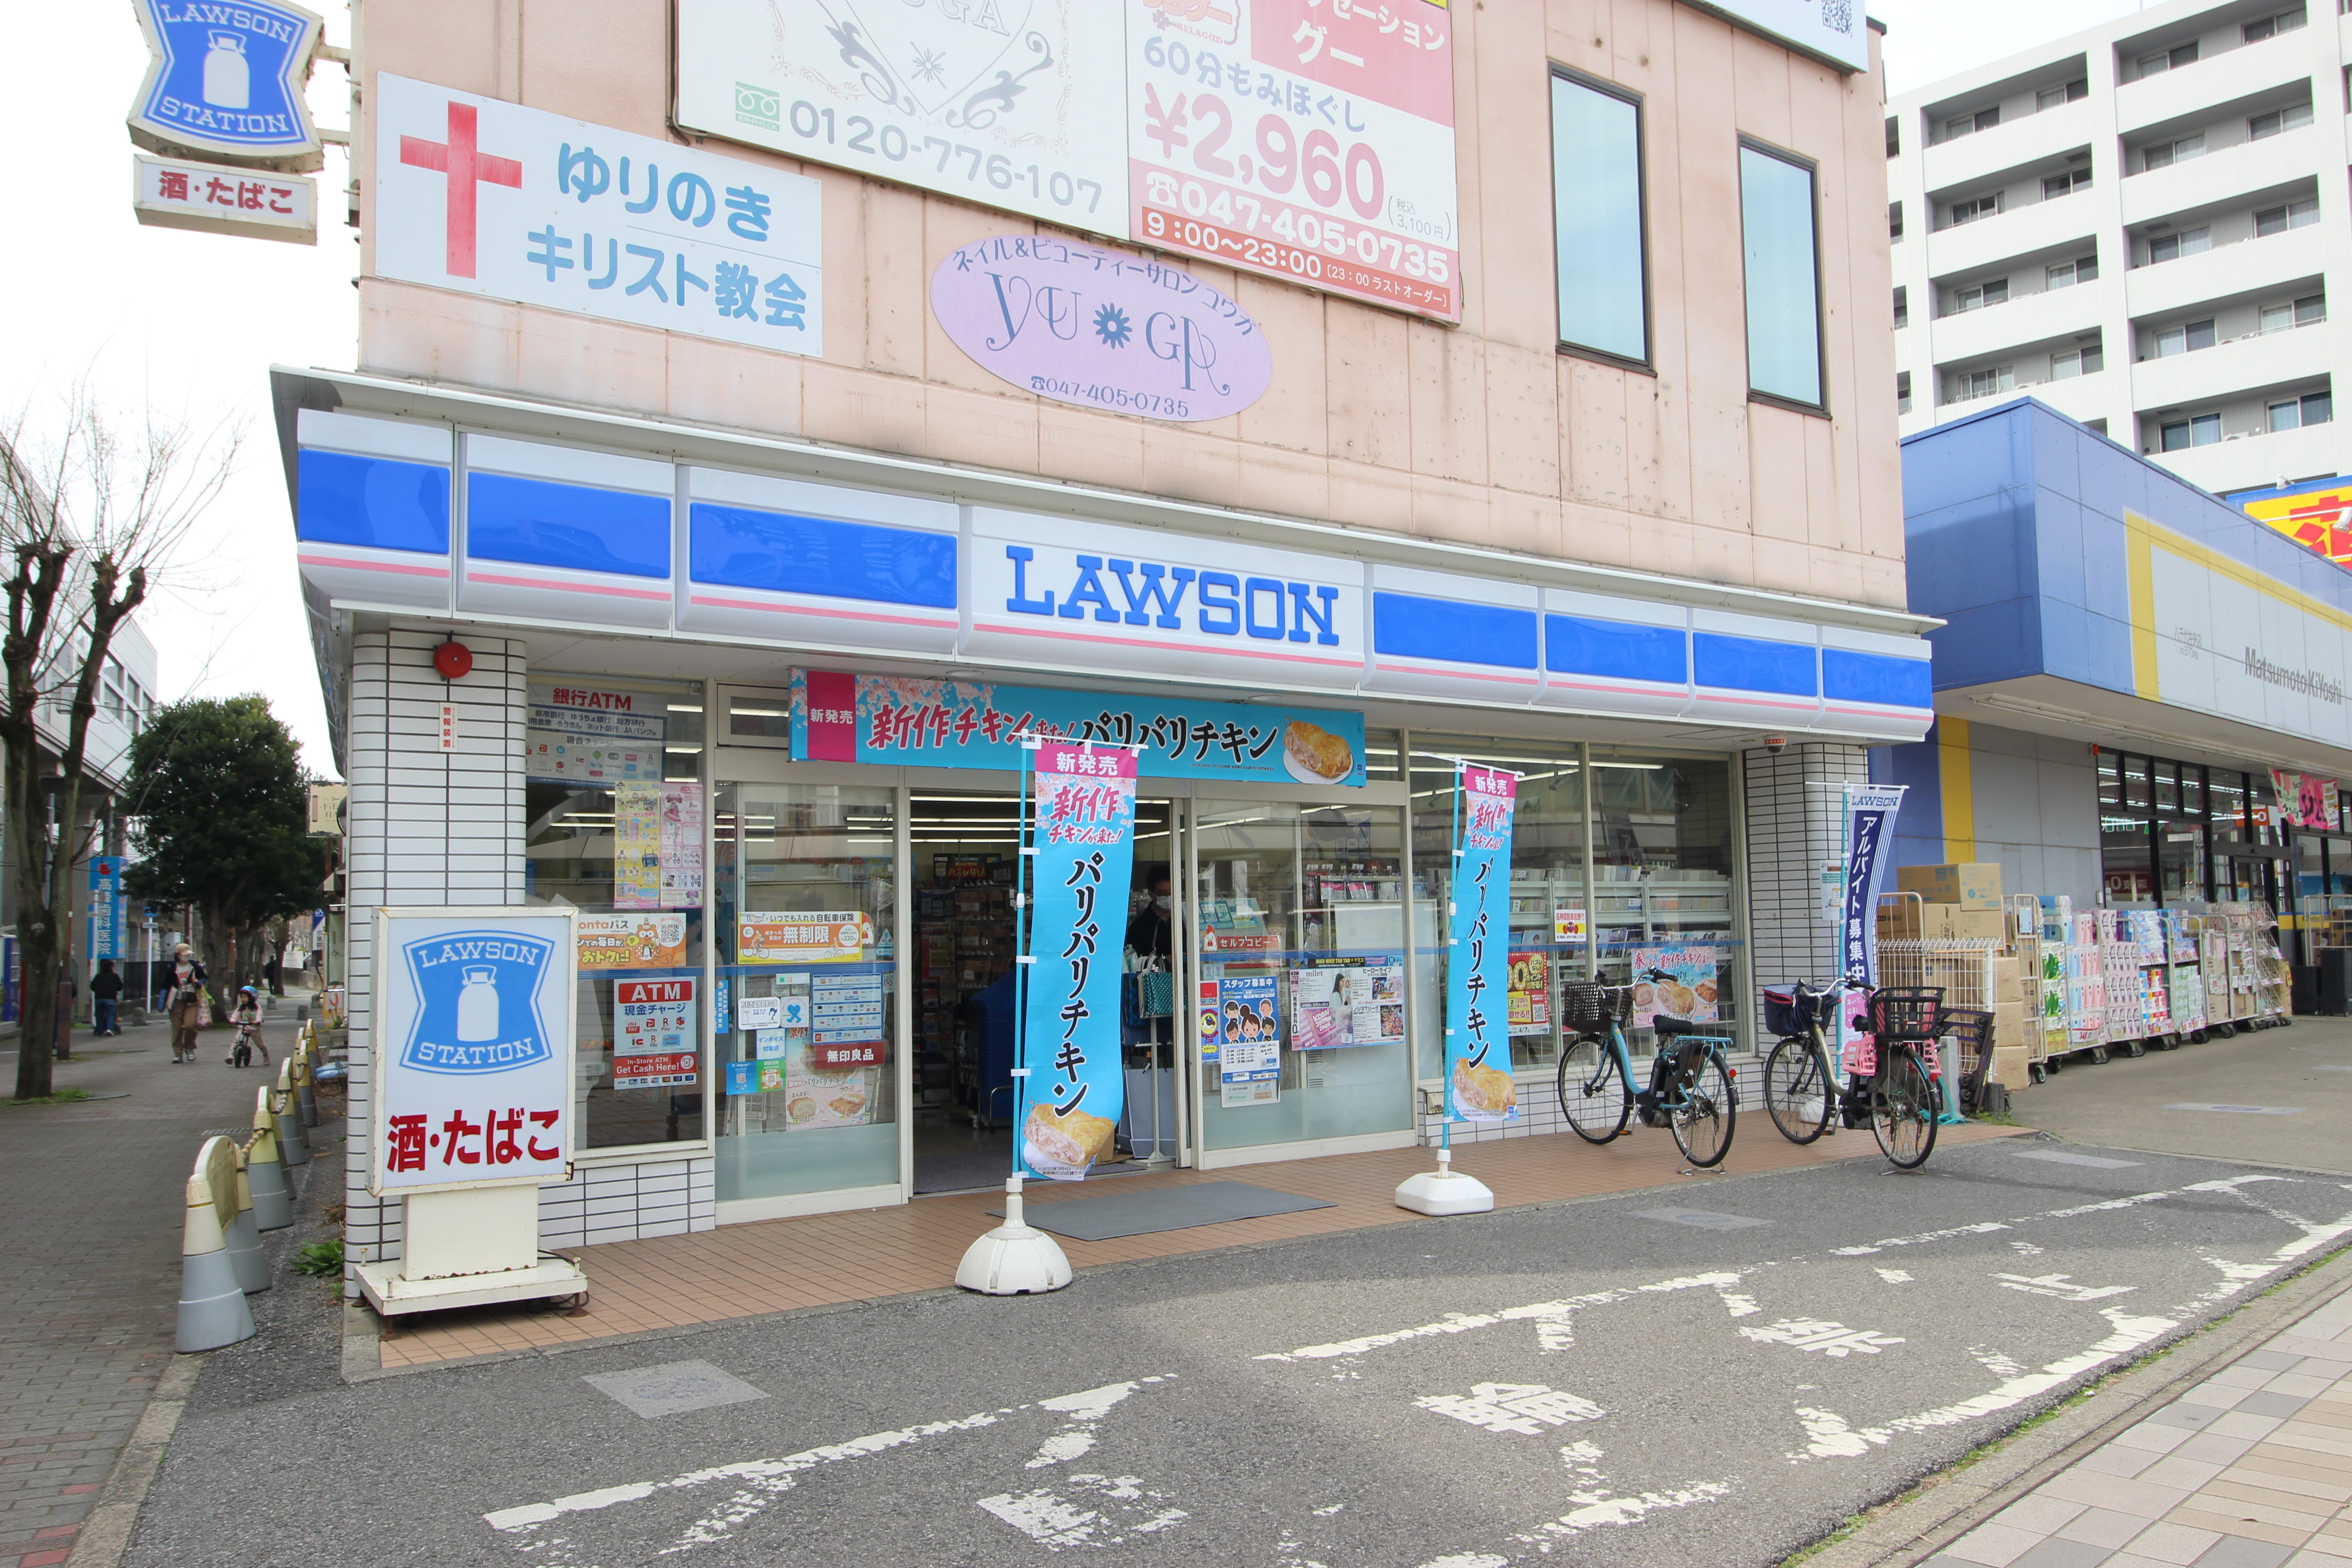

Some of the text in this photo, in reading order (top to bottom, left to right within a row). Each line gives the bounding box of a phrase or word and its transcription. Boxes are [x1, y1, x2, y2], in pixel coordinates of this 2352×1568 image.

[161, 4, 293, 44] LAWSON
[902, 0, 1010, 37] GA
[1292, 20, 1364, 68] グー
[1144, 36, 1365, 132] 60分もみほぐし
[160, 96, 289, 133] STATION
[789, 100, 1102, 213] 0120-776-107
[1144, 82, 1385, 220] ¥2,960
[159, 170, 293, 214] 酒・たばこ
[558, 142, 772, 242] ゆりのき
[1181, 181, 1449, 283] 047-405-0735
[526, 224, 807, 332] キリスト教会
[1045, 377, 1189, 418] 047-405-0735
[1006, 544, 1340, 646] LAWSON
[2245, 646, 2307, 695] Matsumoto
[553, 687, 632, 711] 銀行ATM
[443, 707, 451, 748] 警報装置
[535, 710, 645, 727] 都市銀行 ゆうちょ銀行 地方銀行
[556, 720, 582, 729] ろうきん
[587, 723, 619, 733] ネット銀行
[810, 708, 854, 725] 新発売
[566, 735, 614, 747] 現金チャージ
[1076, 710, 1278, 764] パリパリチキン
[1056, 751, 1118, 776] 新発売
[1475, 774, 1507, 796] 新発売
[1049, 785, 1120, 823] 新作
[1851, 795, 1899, 807] LAWSON
[1849, 816, 1878, 982] アルバイト募集中
[578, 920, 629, 929] ontaパス
[770, 914, 815, 922] いつでも入れる
[817, 913, 855, 922] 自転車保険
[783, 926, 830, 944] 無制限
[1219, 936, 1271, 948] セルフコピー
[418, 941, 539, 968] LAWSON
[581, 950, 631, 964] おトクに!
[1466, 855, 1494, 1070] パリパリチキン
[631, 983, 681, 1001] ATM
[1053, 851, 1104, 1119] パリパリチキン
[1224, 978, 1273, 989] スタッフ募集中
[624, 1003, 687, 1016] 現金チャージ
[417, 1037, 535, 1064] STATION
[627, 1057, 653, 1065] In-Store
[826, 1048, 874, 1063] 無印良品
[633, 1065, 654, 1073] Cash
[657, 1063, 680, 1072] Here!
[803, 1076, 847, 1087] パリパリチキン
[387, 1107, 559, 1172] 酒・たばこ
